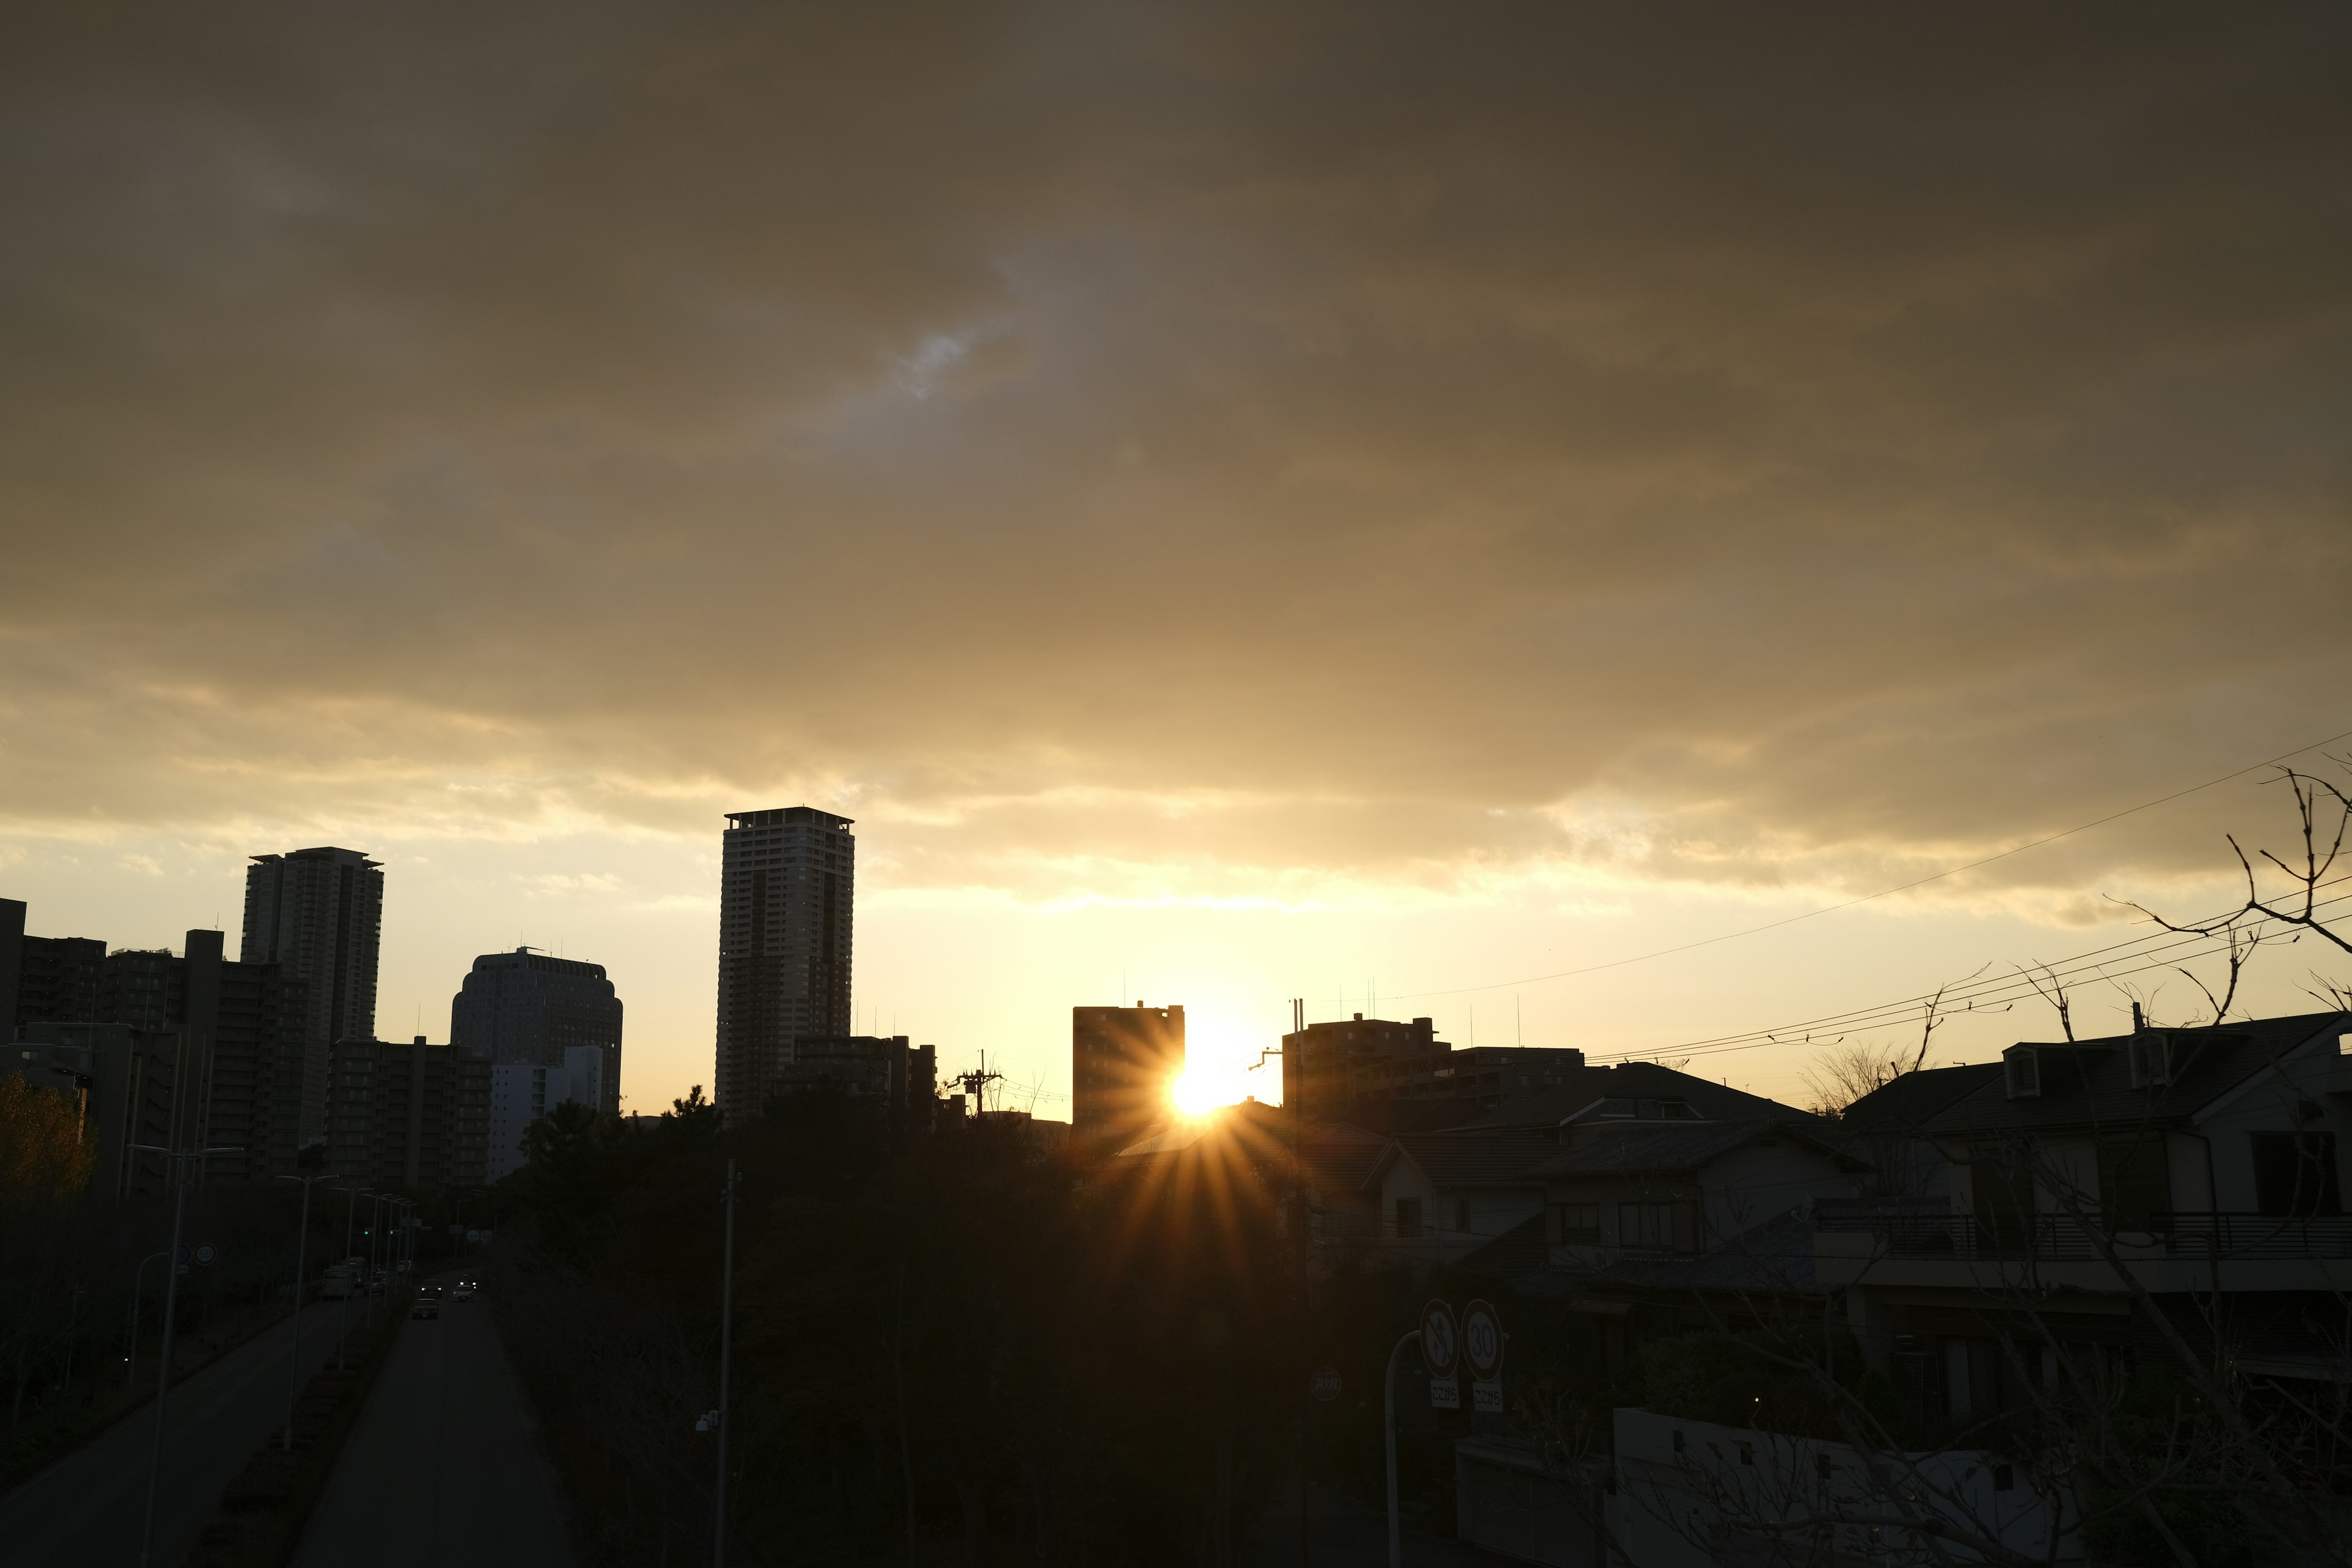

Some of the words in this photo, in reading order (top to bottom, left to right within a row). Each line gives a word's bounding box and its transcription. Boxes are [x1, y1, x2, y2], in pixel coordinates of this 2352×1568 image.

[199, 1249, 211, 1259] 50
[1471, 1324, 1493, 1357] 30
[1314, 1378, 1339, 1390] 消火栓
[1432, 1386, 1457, 1401] ここから
[1475, 1389, 1501, 1405] ここから
